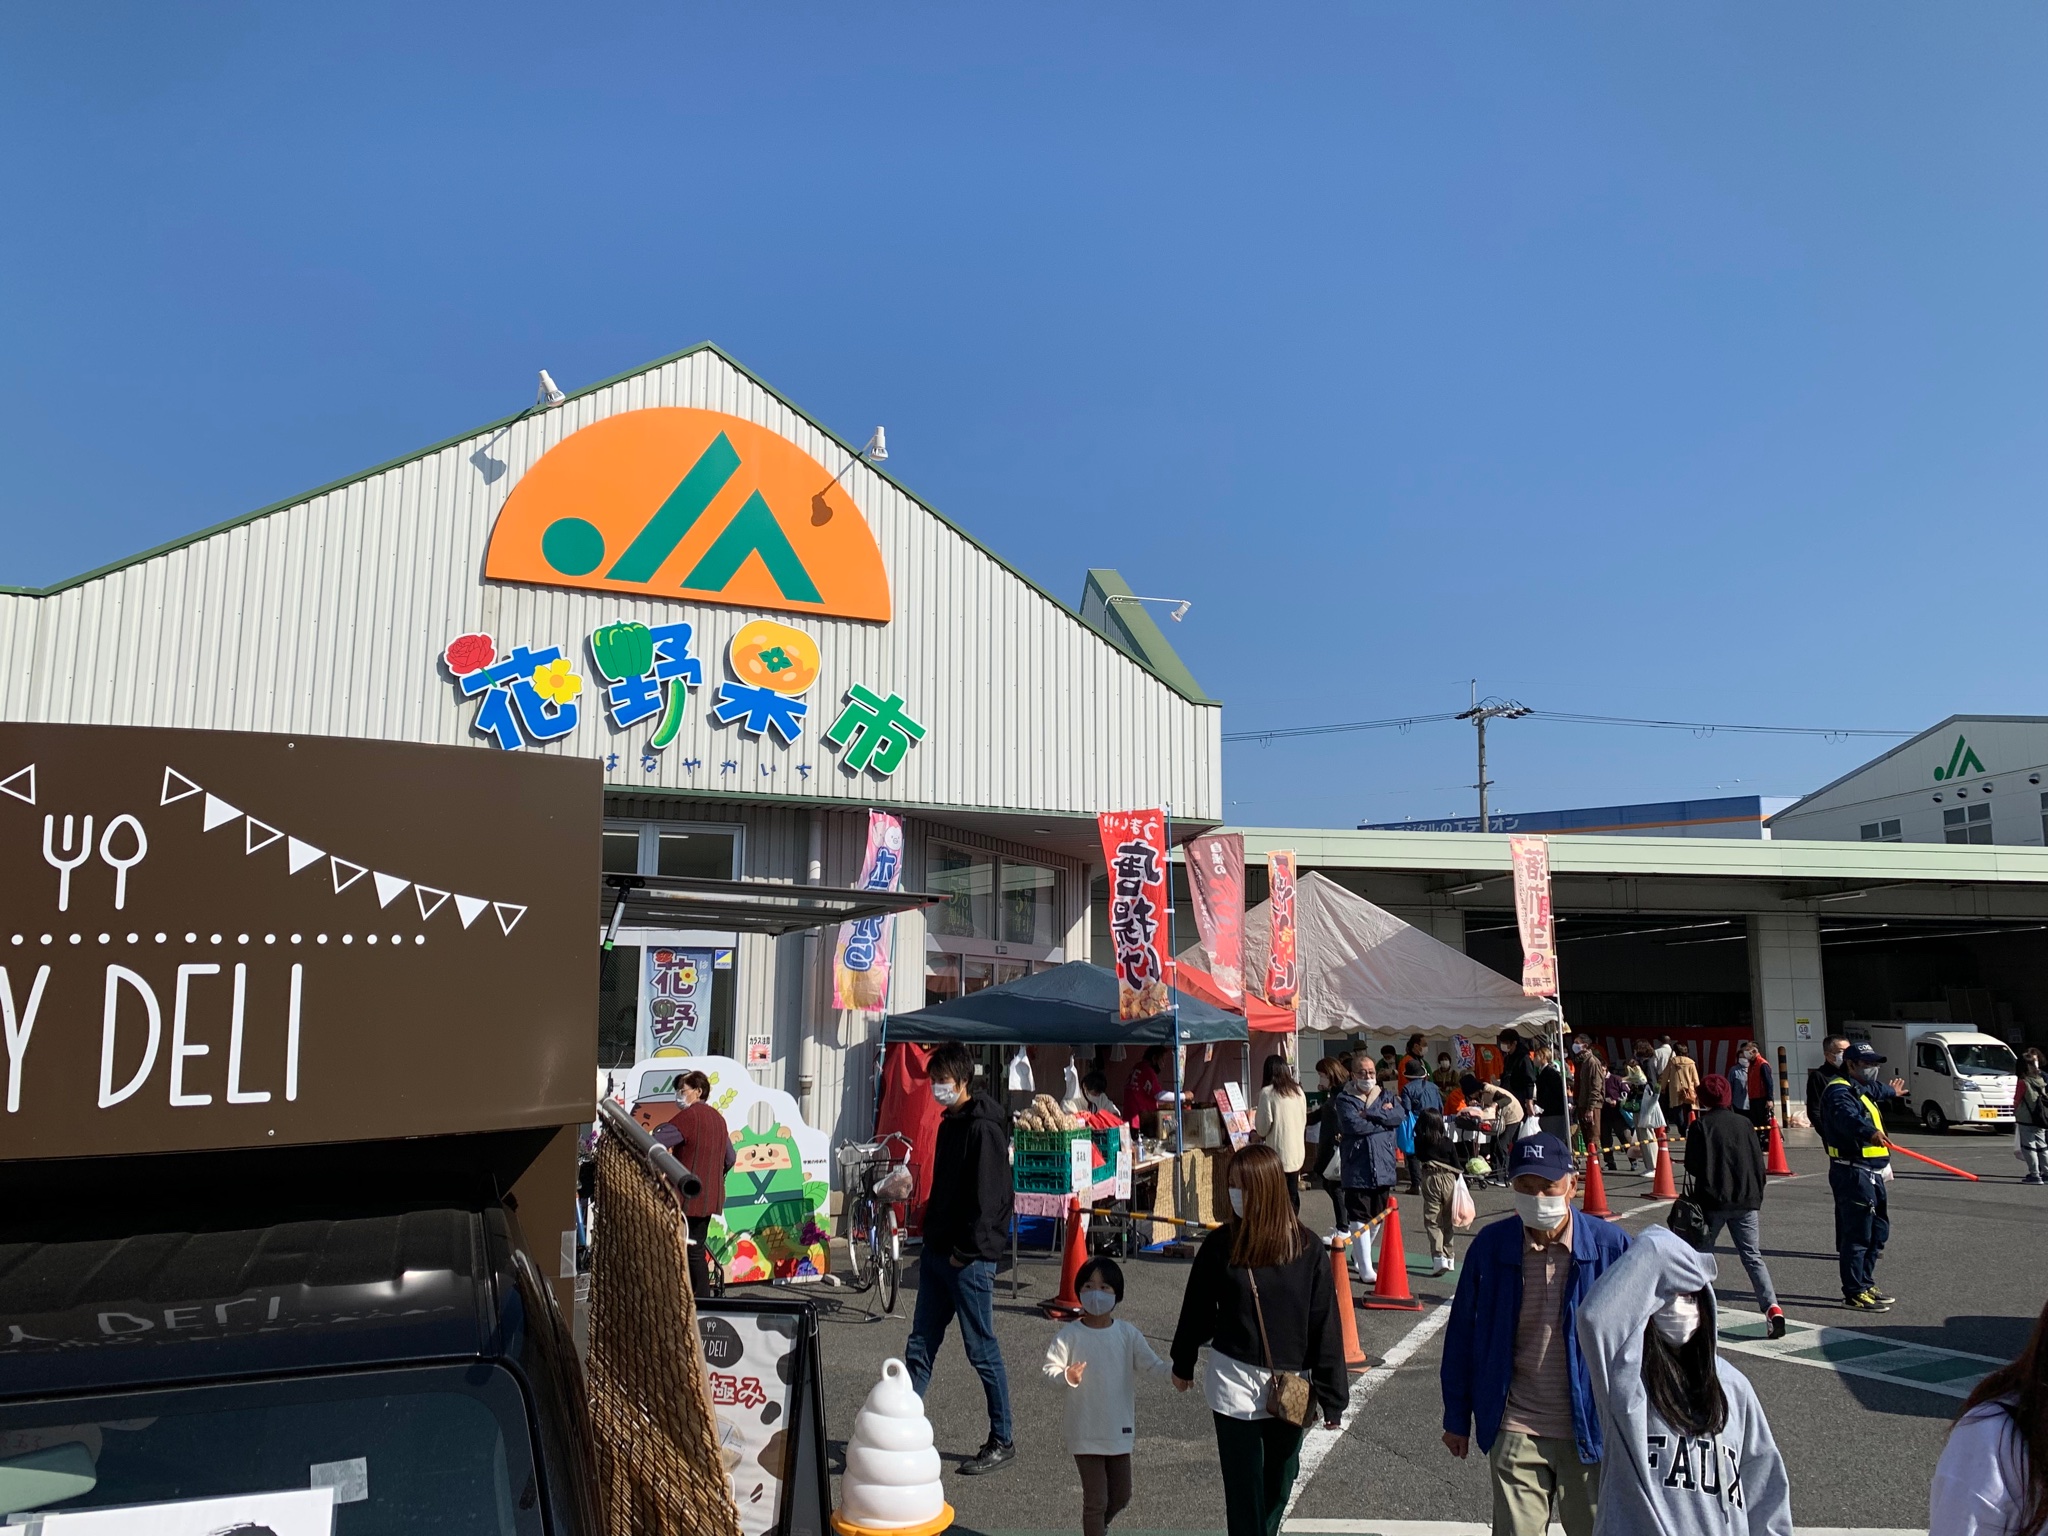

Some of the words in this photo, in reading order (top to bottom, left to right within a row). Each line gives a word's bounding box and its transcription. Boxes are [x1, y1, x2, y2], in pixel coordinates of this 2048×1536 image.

[98, 963, 303, 1108] DELI
[650, 948, 699, 1058] 花野
[708, 1340, 728, 1357] DELI
